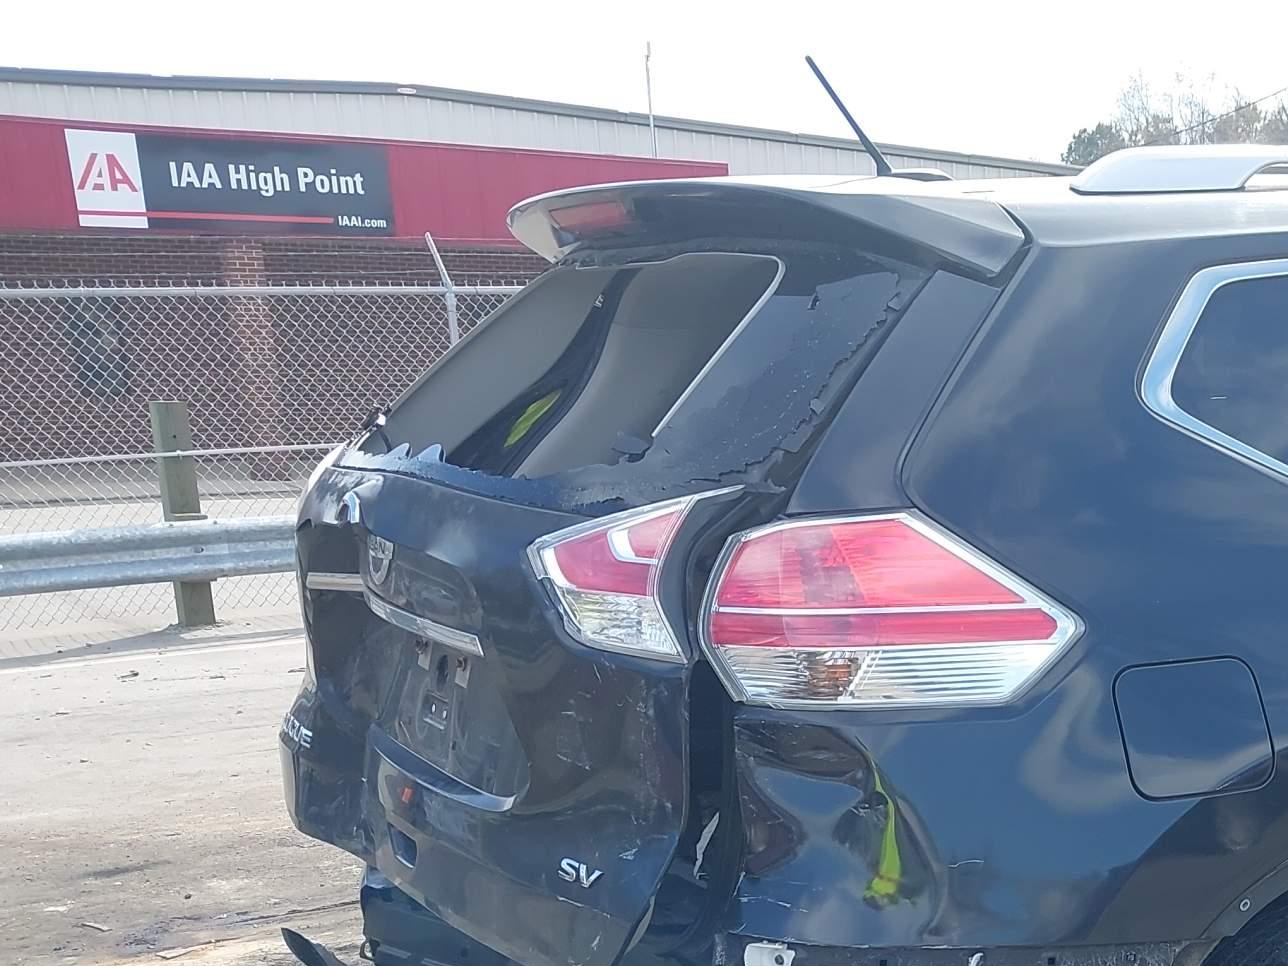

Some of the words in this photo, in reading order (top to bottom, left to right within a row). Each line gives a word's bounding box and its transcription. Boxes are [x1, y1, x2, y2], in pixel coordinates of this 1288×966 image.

[169, 161, 223, 189] IAA
[228, 164, 291, 197] High
[297, 167, 365, 195] Point
[338, 215, 388, 229] IAAI.com
[558, 857, 604, 889] SV
